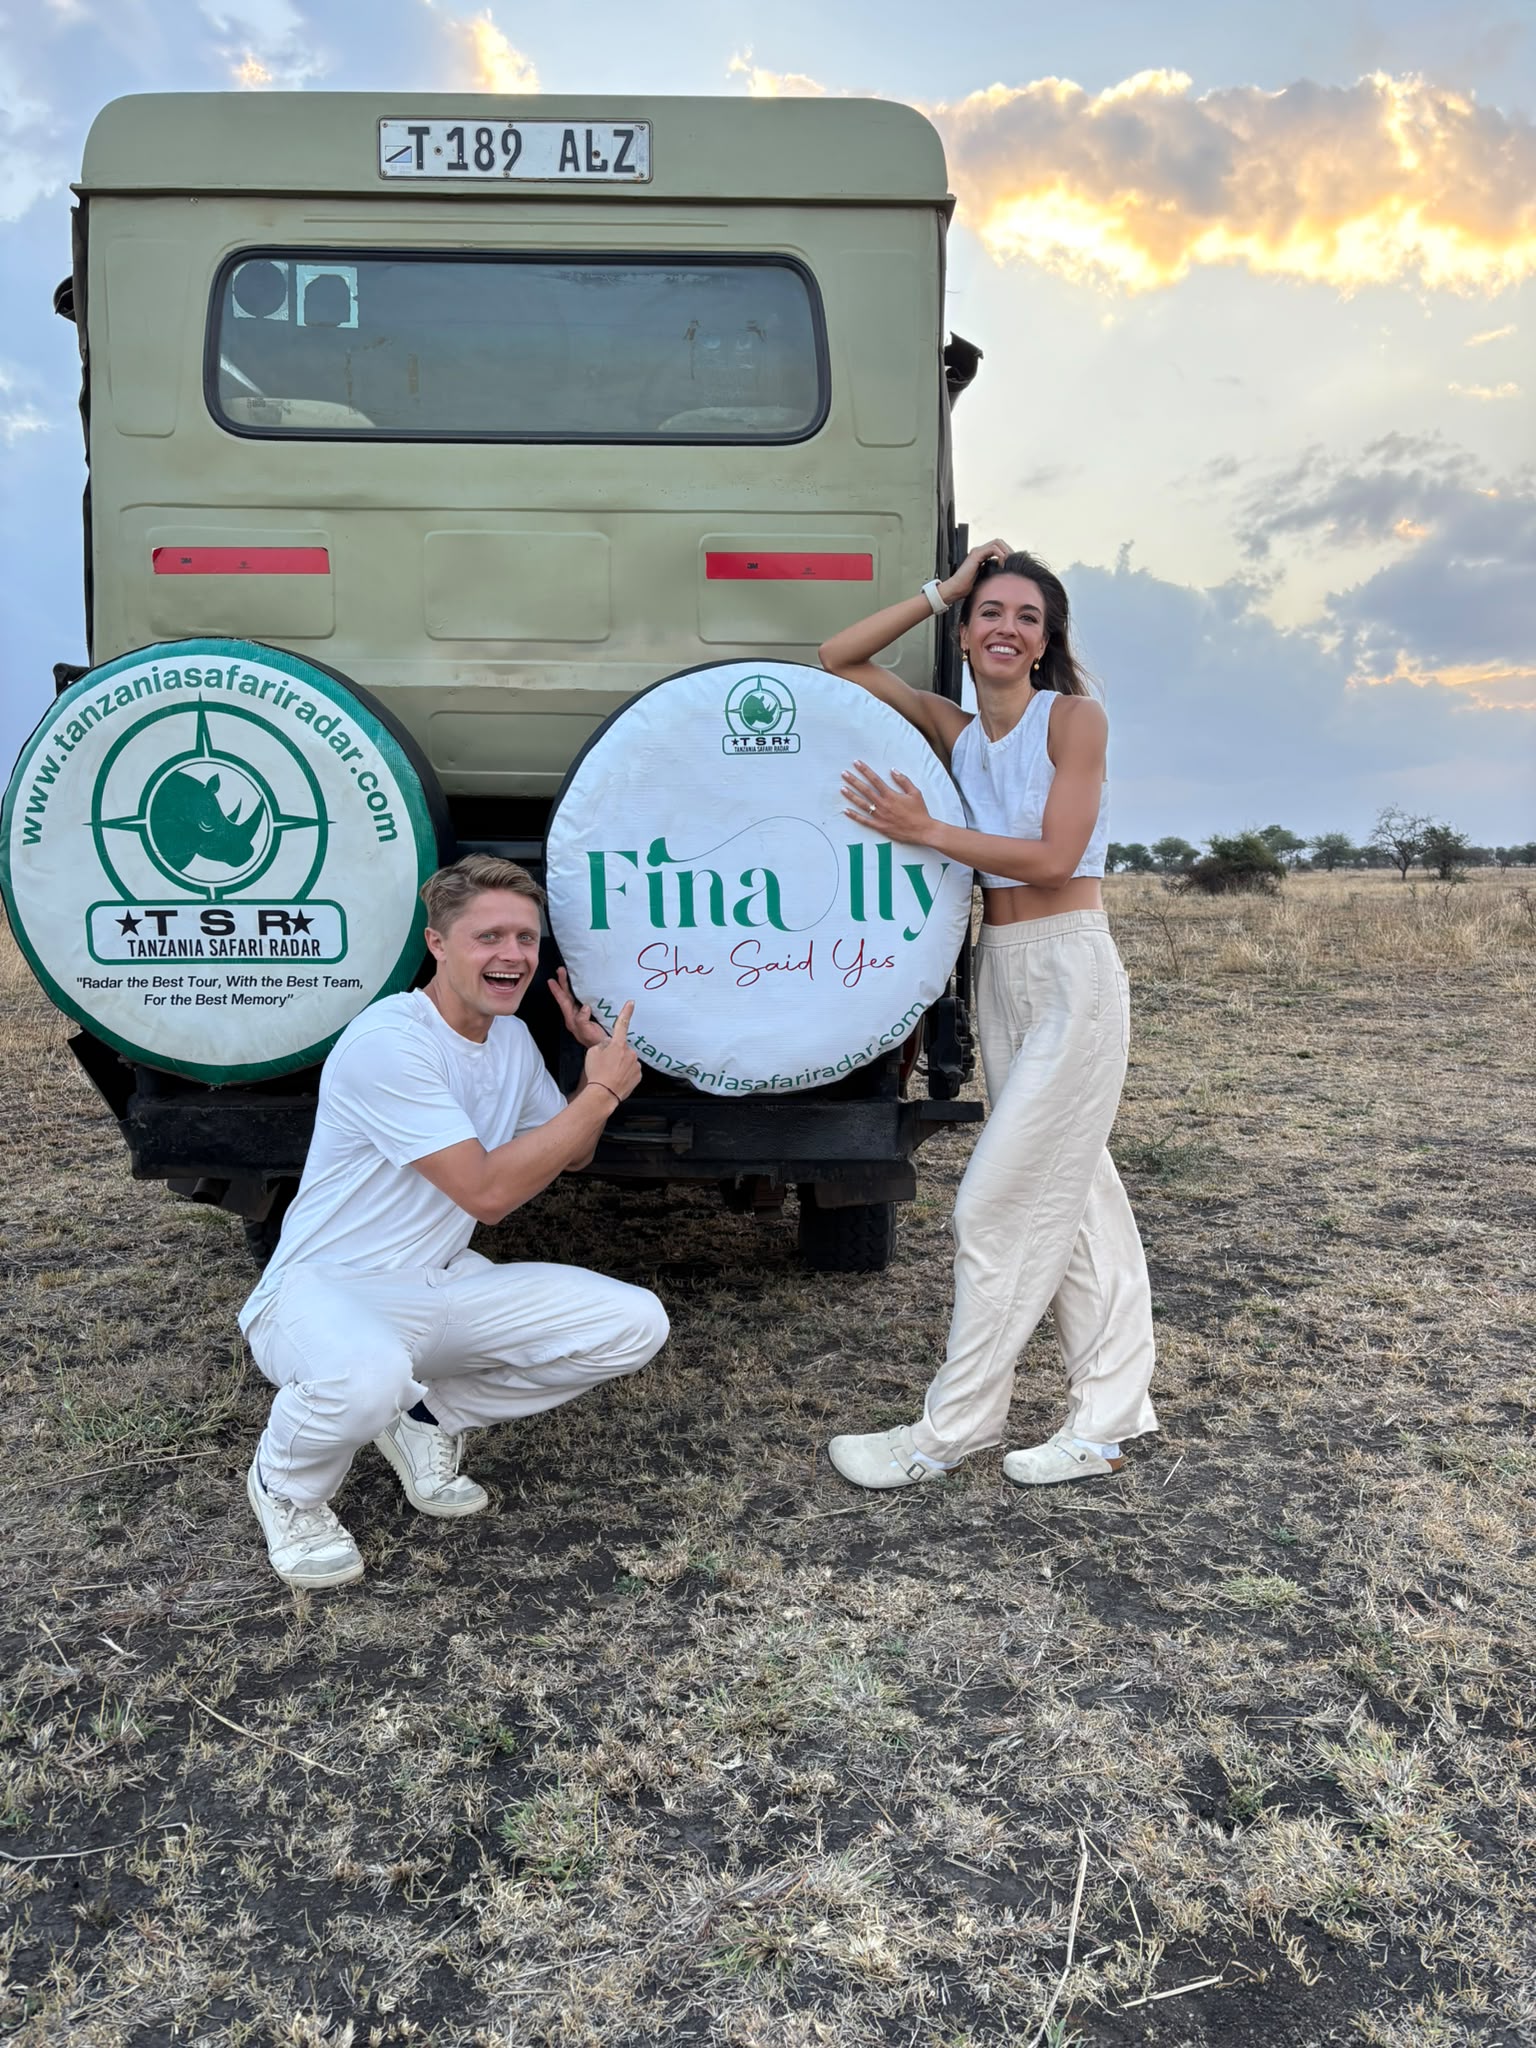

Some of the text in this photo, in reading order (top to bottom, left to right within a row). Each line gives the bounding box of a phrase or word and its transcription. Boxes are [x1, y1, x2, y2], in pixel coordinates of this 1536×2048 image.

[407, 126, 636, 173] T 189 ALZ
[22, 664, 398, 846] www.tanzaniasafariradar.com
[127, 938, 321, 957] TANZANIA SAFARI RADAR
[637, 938, 895, 990] She Said Yes
[77, 976, 363, 989] "Radar the Best Tour, With the Best Team,
[144, 994, 167, 1006] For
[170, 994, 192, 1006] the
[195, 994, 228, 1005] Best
[596, 997, 926, 1091] w.tanzaniasafariradar.com
